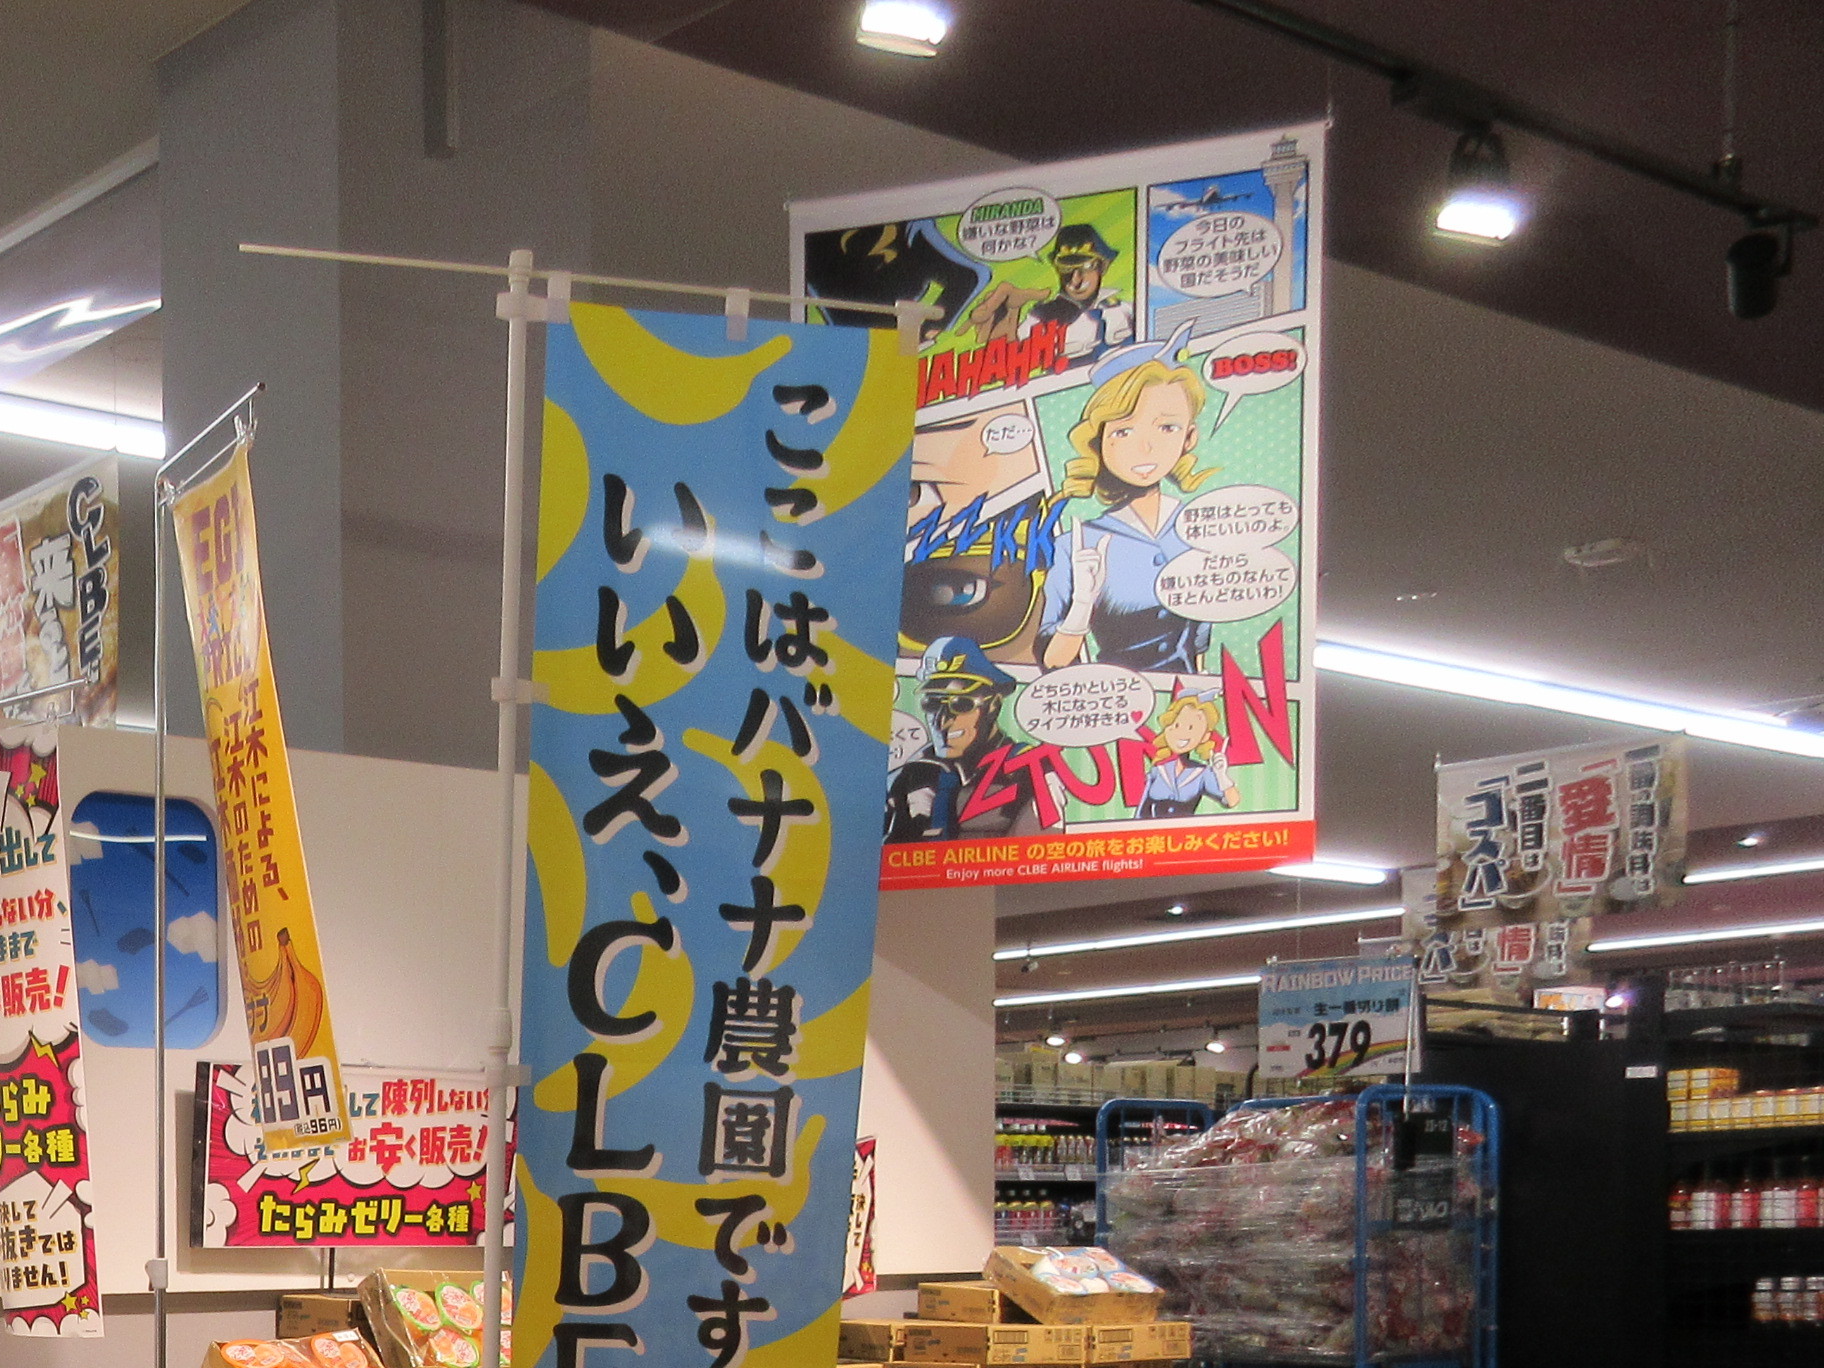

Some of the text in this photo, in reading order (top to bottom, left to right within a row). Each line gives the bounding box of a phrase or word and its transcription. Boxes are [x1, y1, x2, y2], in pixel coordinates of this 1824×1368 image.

[962, 216, 1055, 243] 嫌いな野菜は
[1196, 216, 1244, 233] 今日の
[981, 235, 1038, 256] 何かな?
[1175, 230, 1265, 253] フライト先は
[1163, 244, 1278, 275] 野菜の美味しい
[1180, 264, 1261, 288] 国だそうだ
[1211, 349, 1299, 378] BOSS!
[1183, 502, 1292, 523] 野菜はとっても
[1185, 518, 1290, 538] 体にいいのよ。
[1202, 552, 1248, 570] だから
[1159, 568, 1289, 591] 嫌いなものなんて
[1168, 584, 1283, 607] ほとんどないわ!
[1029, 677, 1142, 700] どちらかというと
[1042, 696, 1129, 716] 木になってる
[889, 829, 1290, 867] CLBE AIRLINE の空の旅をお楽しみください!
[946, 856, 1144, 880] Enjoy more CLBE AIRLINE flights!
[1261, 964, 1413, 993] RAINBOW PRICE
[1305, 1019, 1371, 1071] 379
[0, 1200, 38, 1223] 決して
[259, 1193, 471, 1241] たらみゼリー各種
[0, 1260, 69, 1293] りません!
